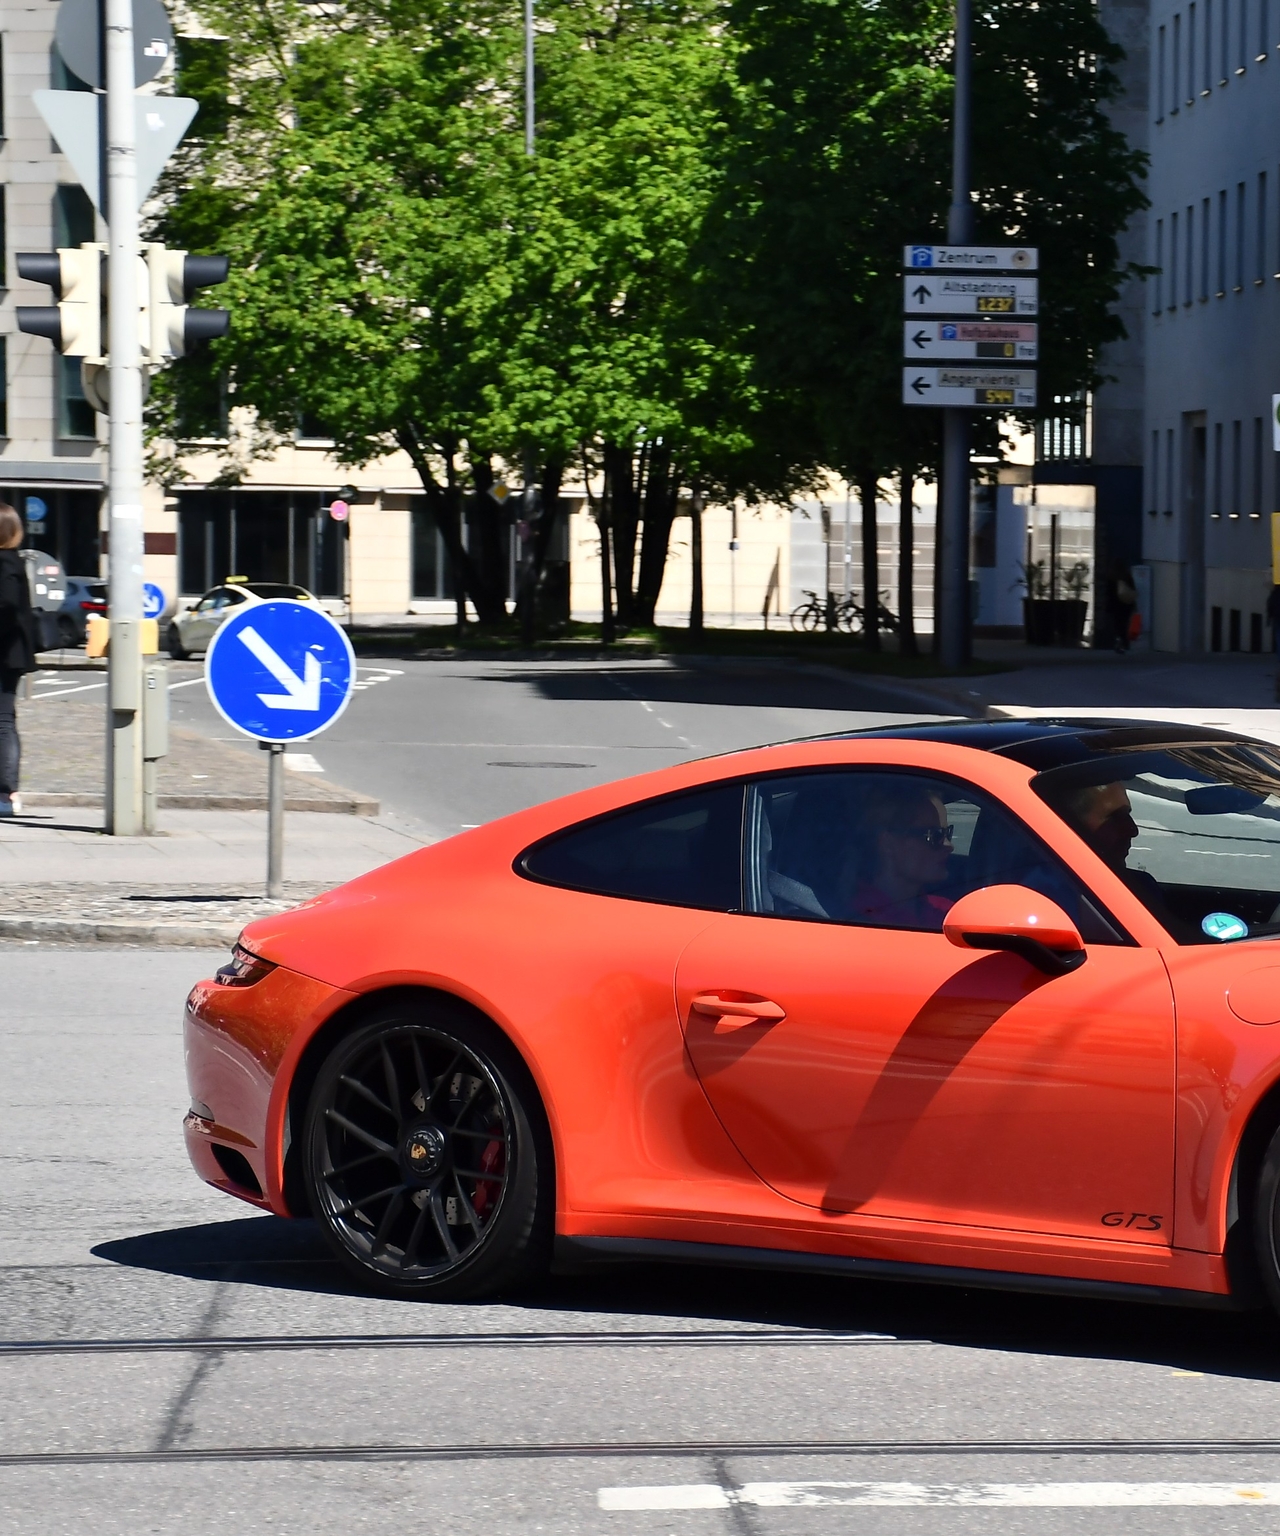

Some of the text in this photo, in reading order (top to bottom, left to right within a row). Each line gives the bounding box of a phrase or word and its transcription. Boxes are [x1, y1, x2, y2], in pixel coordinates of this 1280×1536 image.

[918, 250, 998, 265] P Zentrum
[943, 282, 1017, 296] Altstadtring
[979, 298, 1036, 311] 1237 frei
[1019, 345, 1036, 356] frei
[941, 373, 1020, 387] Angerviertel
[986, 390, 1034, 403] 544 frei
[1213, 917, 1228, 929] 4
[1101, 1211, 1164, 1231] GTS
